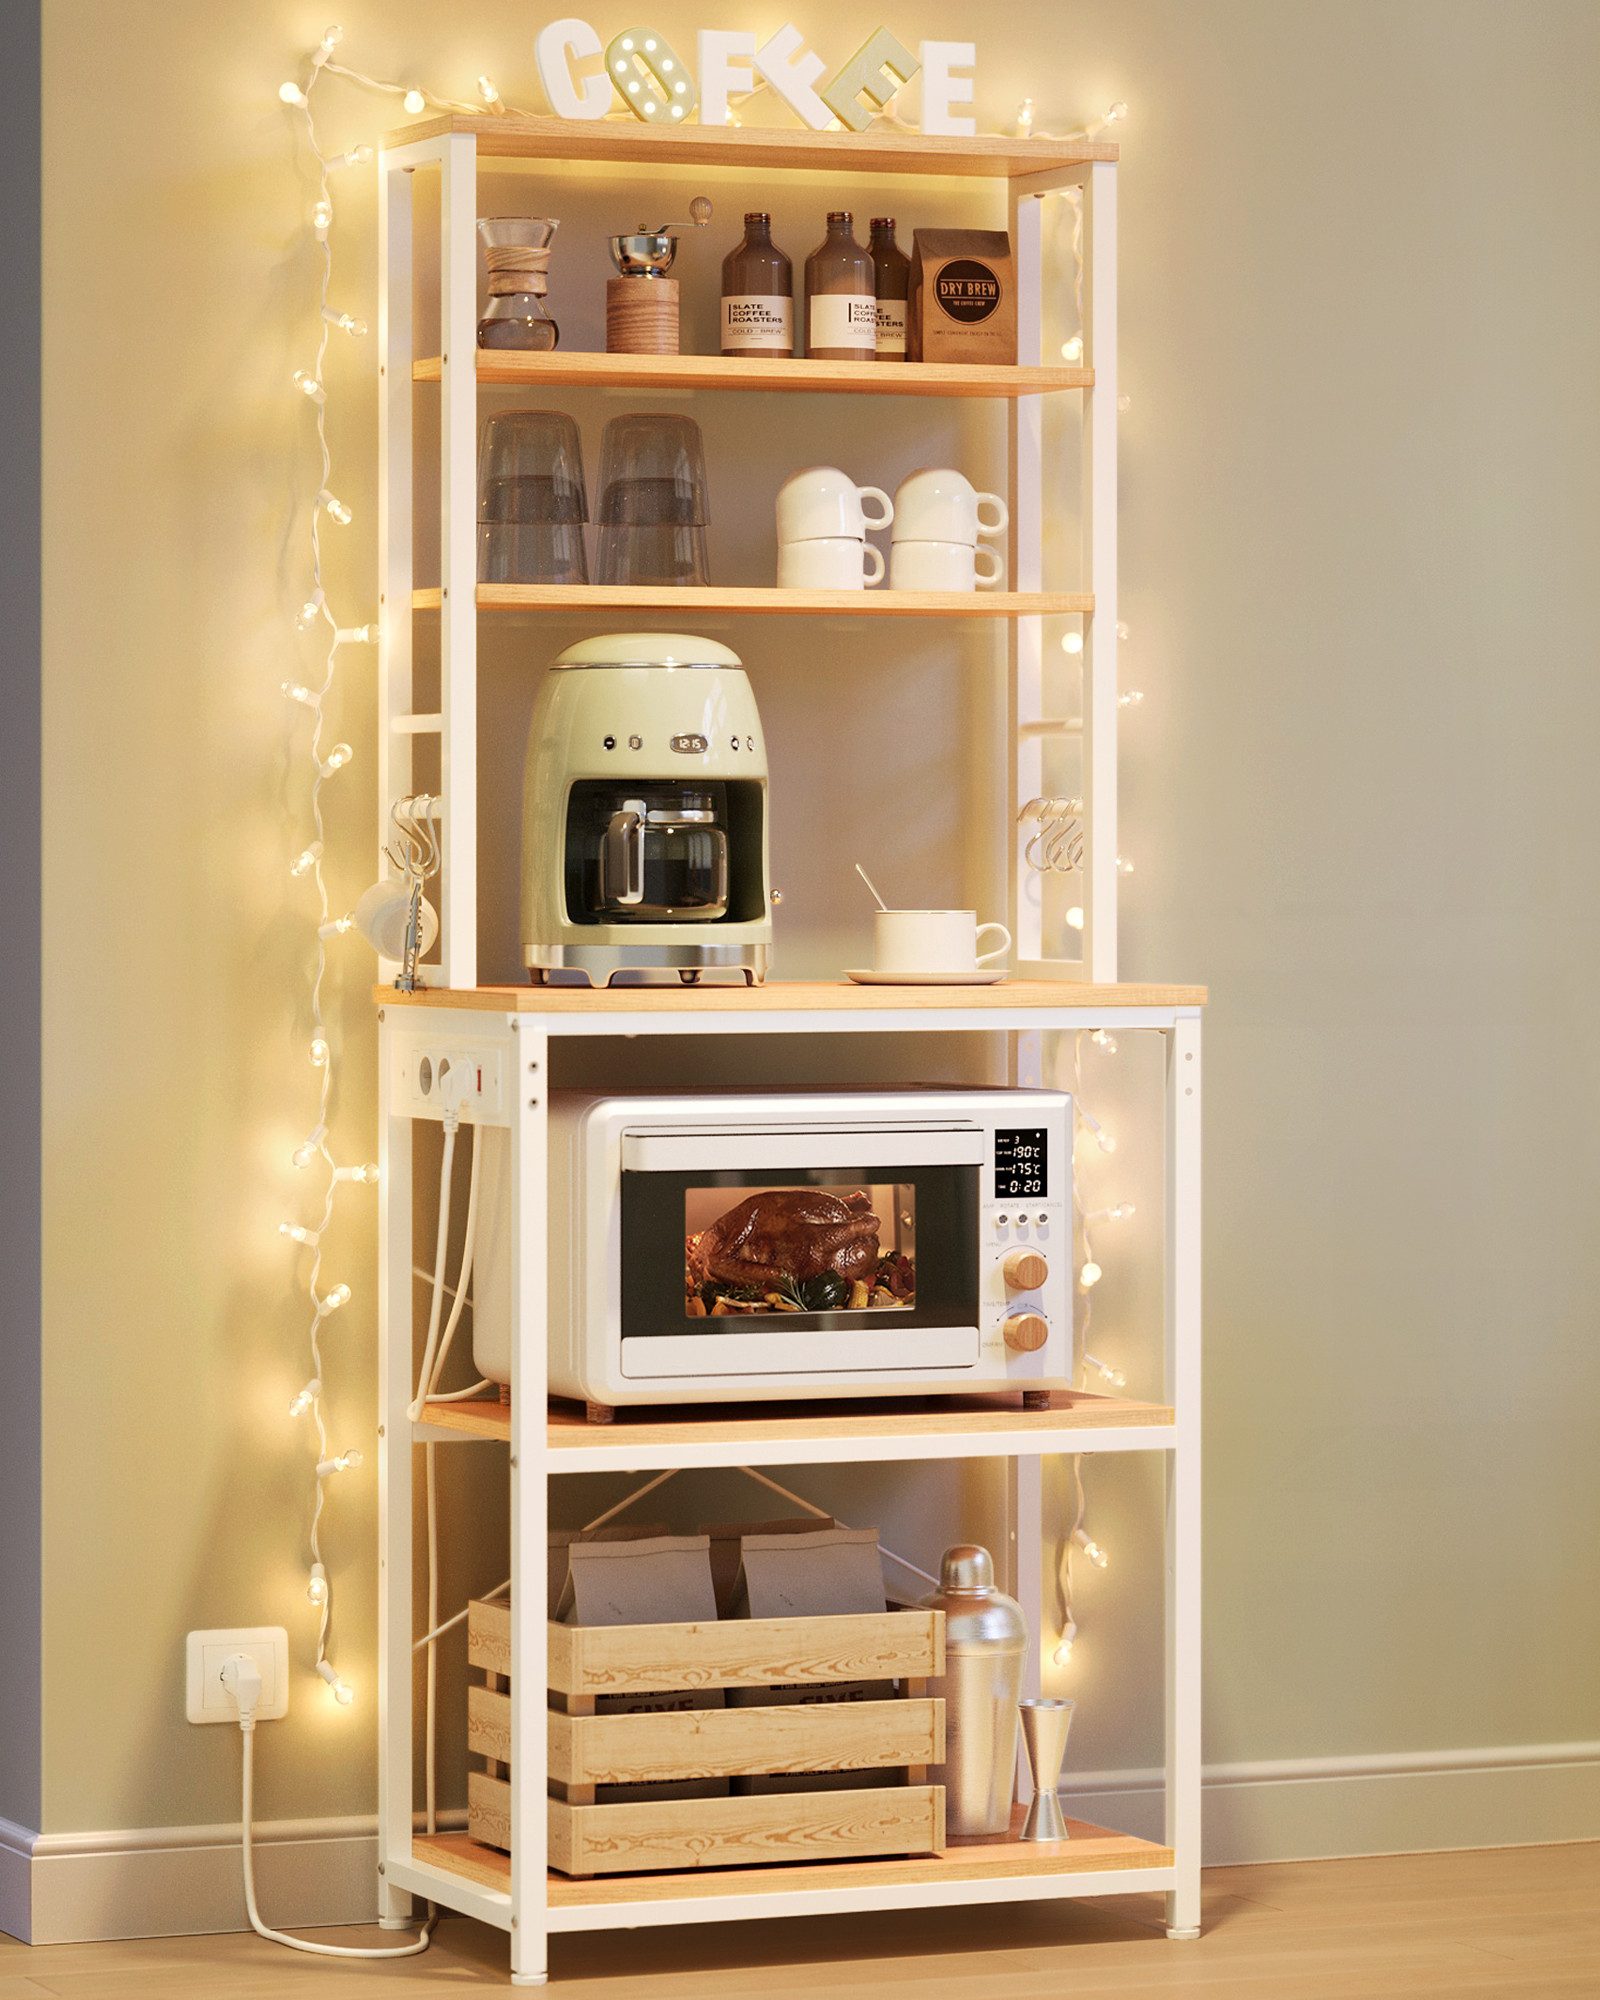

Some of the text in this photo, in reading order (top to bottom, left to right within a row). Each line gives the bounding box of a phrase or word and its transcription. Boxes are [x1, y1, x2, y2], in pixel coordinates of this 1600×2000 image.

[534, 18, 976, 136] COFFEE
[940, 282, 996, 296] DRY BREW
[1014, 1135, 1020, 1145] 3
